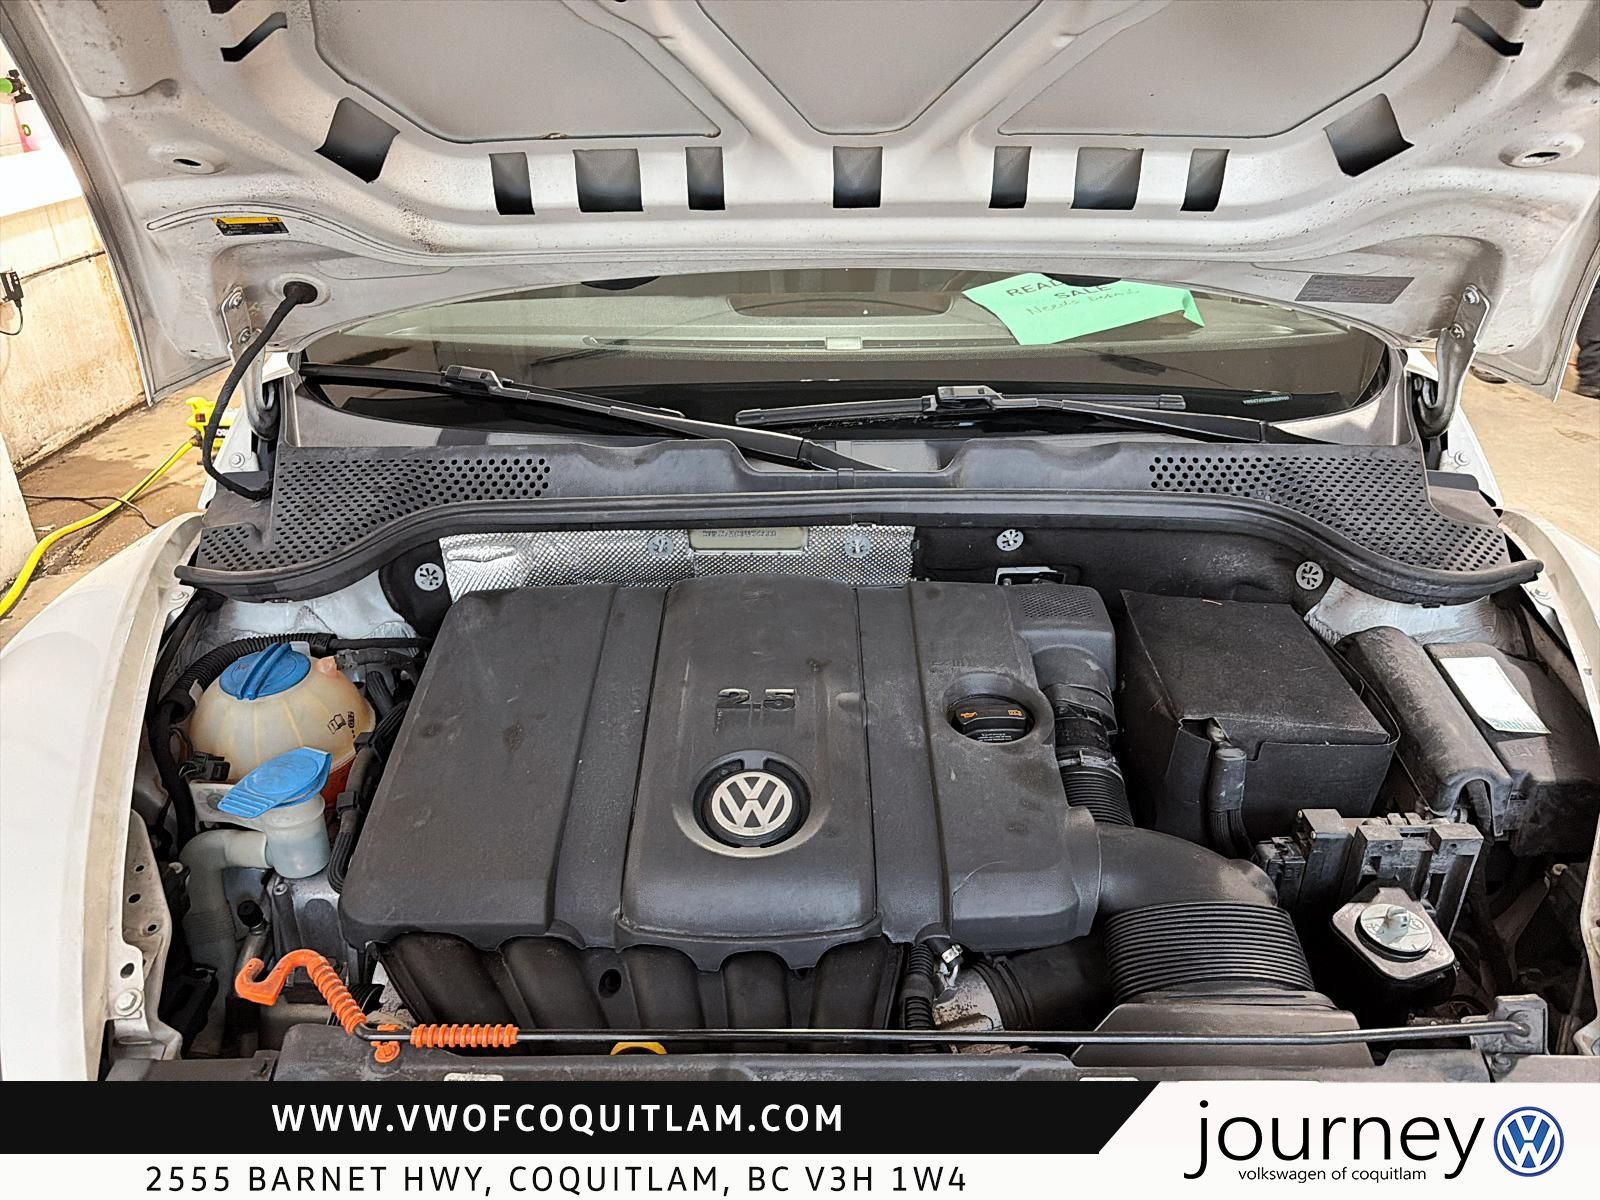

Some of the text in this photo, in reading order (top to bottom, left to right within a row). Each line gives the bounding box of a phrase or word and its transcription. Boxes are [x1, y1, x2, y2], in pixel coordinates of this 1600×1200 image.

[1054, 285, 1112, 299] SALE
[715, 688, 796, 711] 2.5
[711, 771, 793, 837] VW
